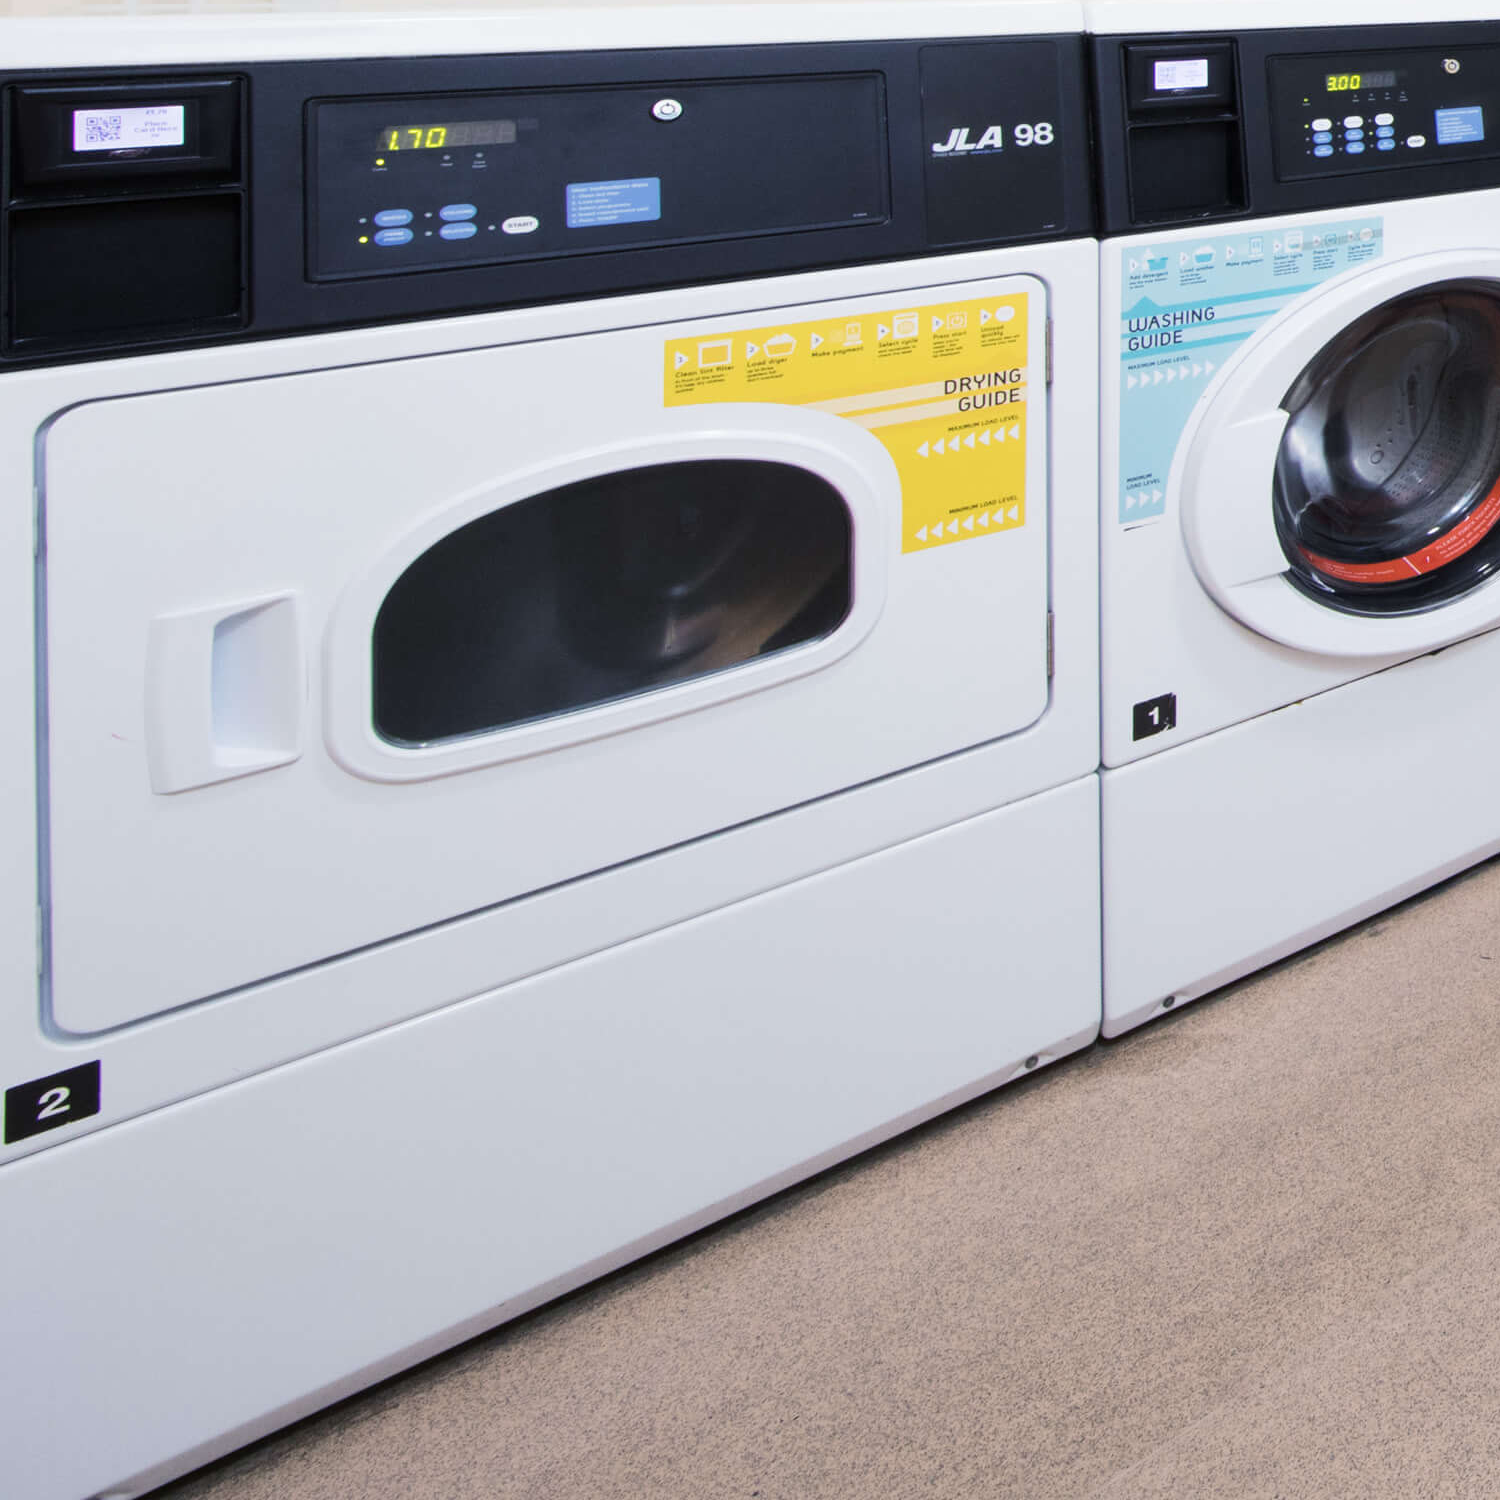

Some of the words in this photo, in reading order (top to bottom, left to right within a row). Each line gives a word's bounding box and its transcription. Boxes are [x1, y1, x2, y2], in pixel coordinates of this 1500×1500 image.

[1328, 75, 1360, 91] 3.00
[932, 125, 1002, 152] JLA
[1014, 122, 1054, 147] 98
[1129, 307, 1214, 332] WASHING
[1129, 330, 1183, 351] GUIDE
[945, 369, 1021, 395] DRYING
[959, 388, 1020, 411] GUIDE
[948, 421, 979, 431] MAXIMUM
[981, 418, 998, 427] LOAD
[1148, 706, 1159, 724] 1
[37, 1086, 70, 1120] 2
